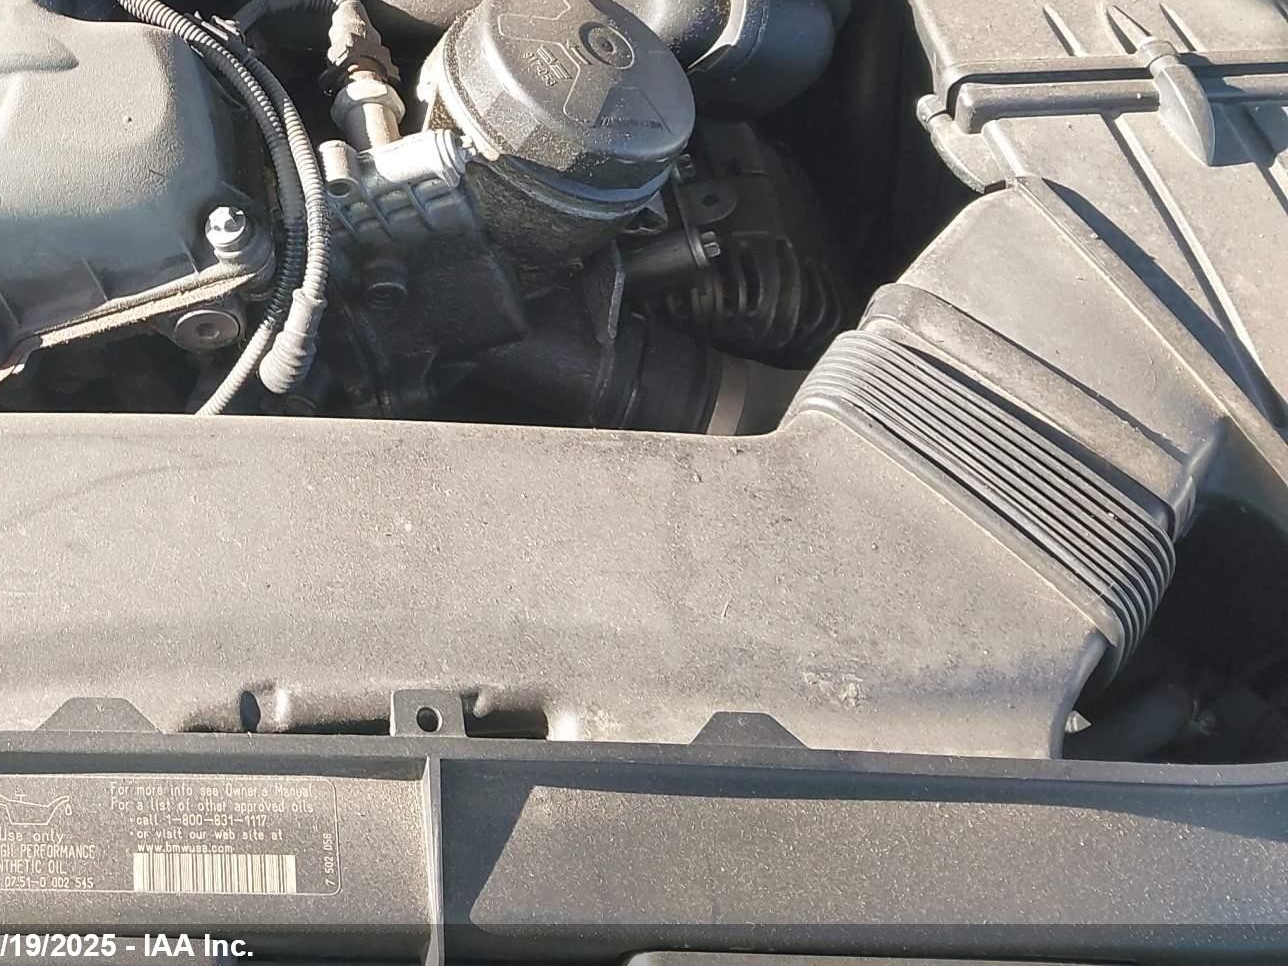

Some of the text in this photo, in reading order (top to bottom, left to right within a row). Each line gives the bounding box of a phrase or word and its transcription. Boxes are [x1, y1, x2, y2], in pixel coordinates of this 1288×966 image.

[111, 781, 129, 795] For
[136, 786, 162, 796] more
[171, 782, 192, 796] info
[200, 787, 218, 797] see
[111, 796, 314, 814] For a list of other approved oils
[136, 814, 267, 826] call 1-800-831-1117
[32, 827, 64, 844] only
[136, 828, 283, 841] or visit our web site at
[20, 843, 96, 859] PERFORMANCE
[137, 840, 233, 853] www.bmwusa.com
[47, 859, 68, 875] OIL
[52, 876, 70, 888] 002
